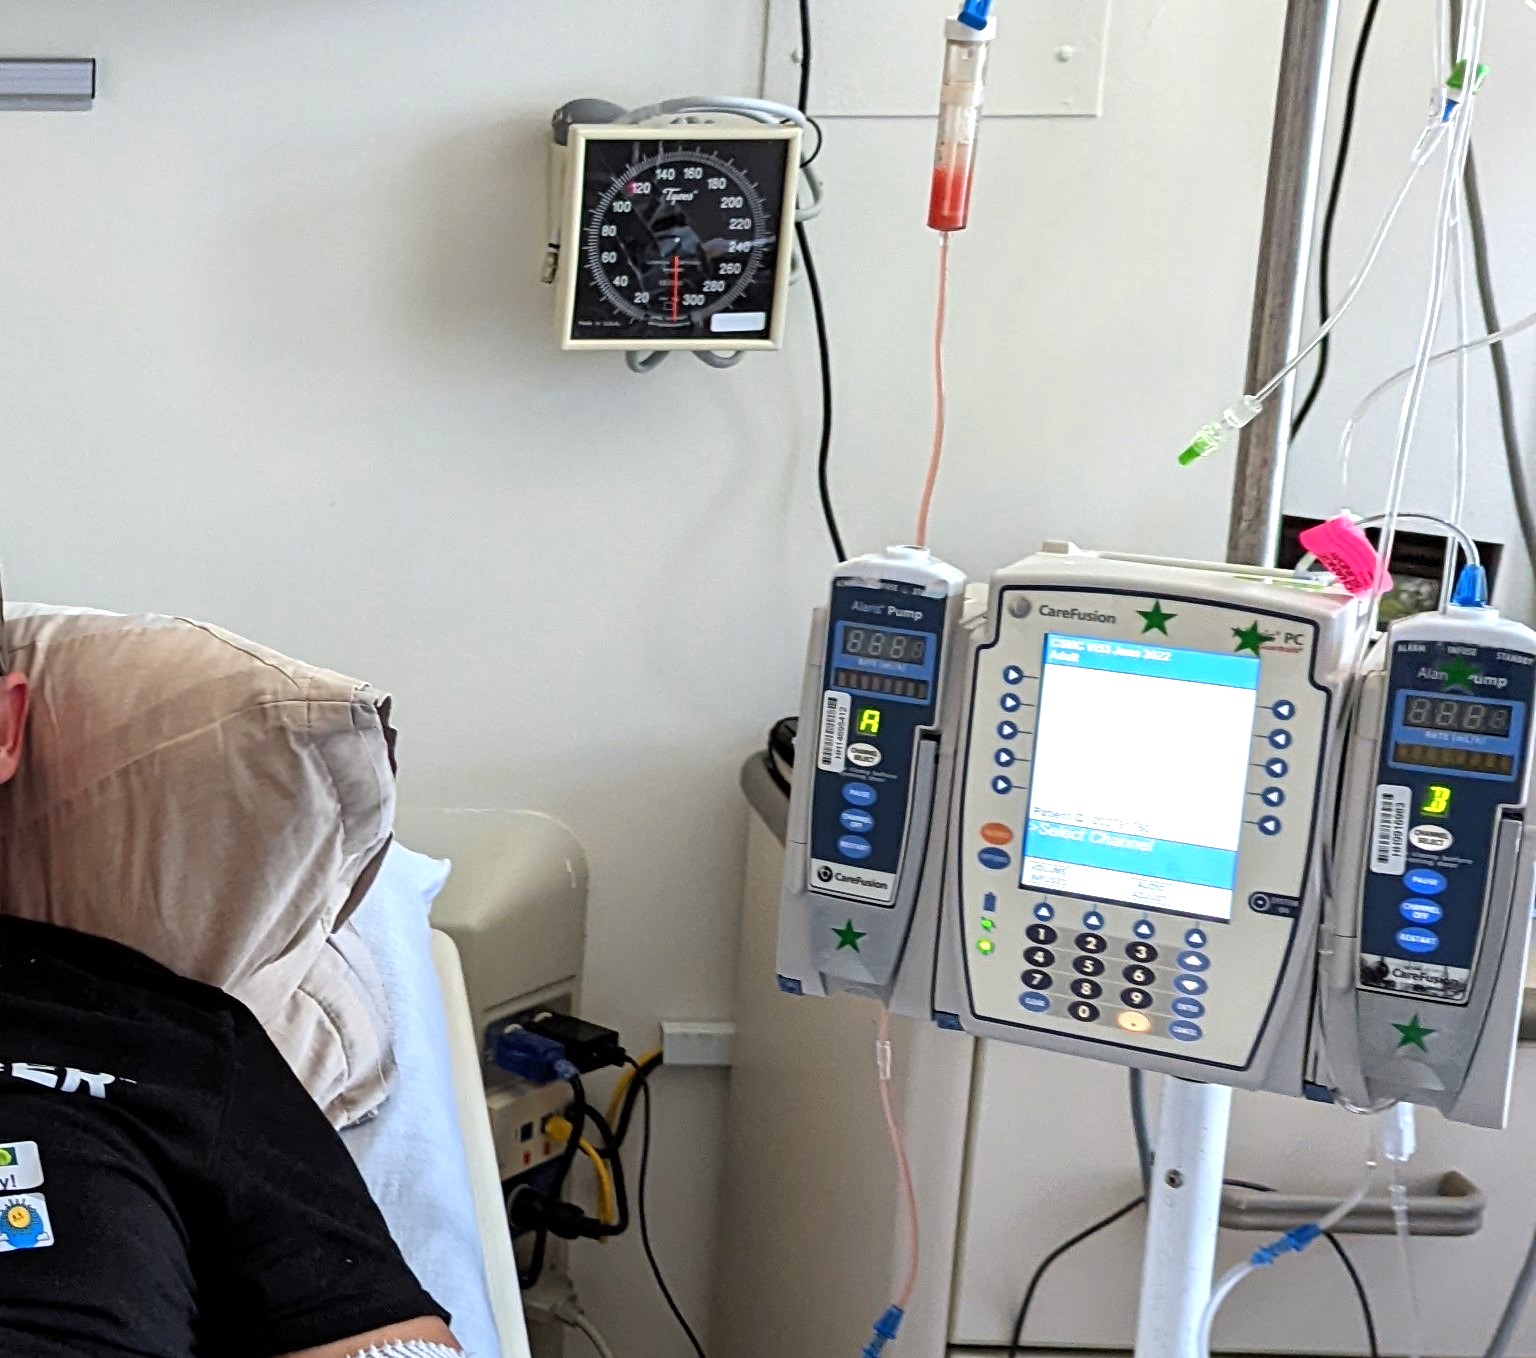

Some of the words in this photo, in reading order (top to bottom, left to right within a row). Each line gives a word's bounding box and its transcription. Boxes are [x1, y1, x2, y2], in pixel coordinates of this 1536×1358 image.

[655, 168, 675, 180] 140
[683, 167, 703, 179] 160
[632, 182, 651, 194] 120
[707, 178, 727, 190] 180
[612, 201, 632, 213] 100
[720, 197, 744, 208] 200
[728, 218, 752, 230] 220
[601, 225, 617, 237] 80
[728, 241, 752, 252] 240
[601, 251, 617, 263] 60
[719, 263, 742, 274] 260
[613, 275, 629, 287] 40
[702, 280, 725, 292] 280
[633, 292, 650, 303] 20
[682, 294, 706, 306] 300
[887, 605, 923, 621] Pump
[1038, 604, 1117, 624] CareFusion
[1283, 632, 1305, 646] PC
[1397, 644, 1426, 653] ALARM
[859, 708, 880, 733] A
[1414, 829, 1448, 840] CHANNEL
[1417, 836, 1444, 847] SELECT
[834, 872, 888, 890] CareFusion
[1403, 902, 1441, 916] CHANNEL
[1412, 911, 1429, 920] OFF
[1037, 928, 1046, 940] 1
[1085, 937, 1097, 949] 2
[1033, 951, 1044, 963] 4
[1136, 946, 1147, 959] 3
[1083, 960, 1094, 972] 5
[1031, 974, 1043, 985] 7
[1133, 969, 1144, 982] 6
[1081, 983, 1092, 995] 8
[1130, 992, 1142, 1005] 9
[1078, 1005, 1090, 1018] 0
